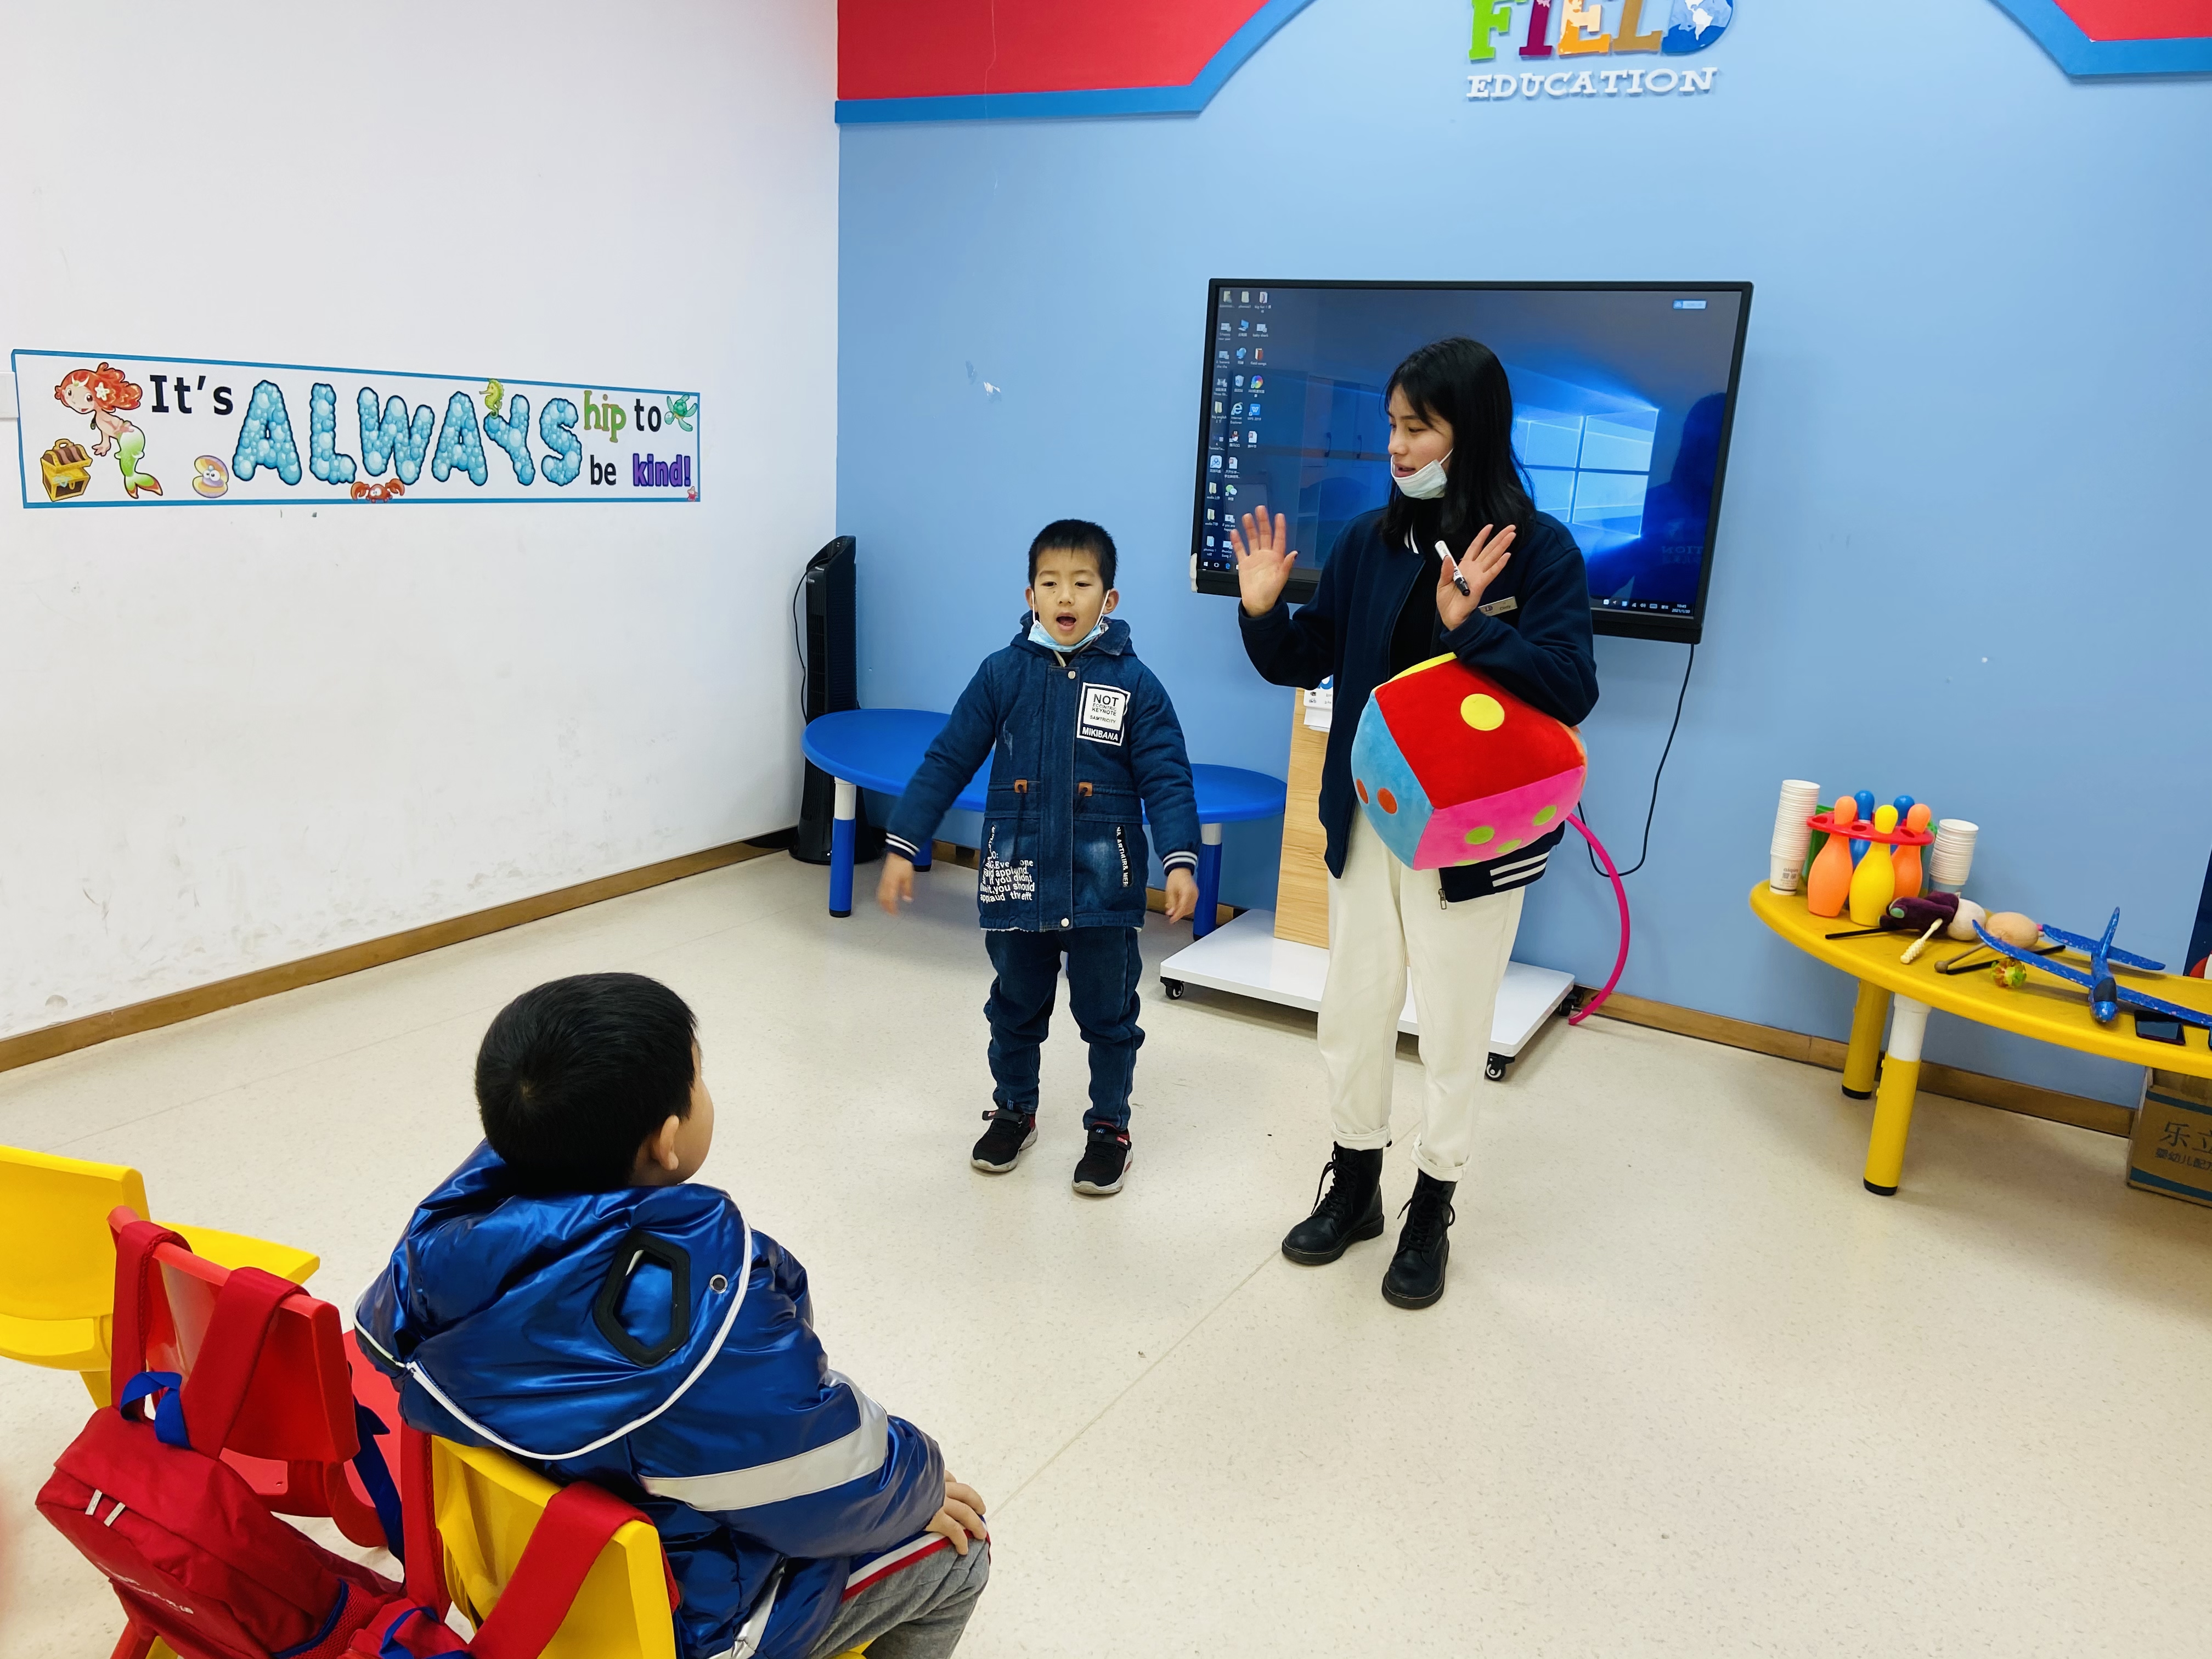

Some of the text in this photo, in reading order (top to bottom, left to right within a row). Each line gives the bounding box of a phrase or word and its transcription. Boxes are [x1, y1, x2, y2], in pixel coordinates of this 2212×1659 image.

[1466, 67, 1718, 99] EDUCATION
[150, 374, 662, 486] It's ALWAYS hip to
[590, 454, 692, 488] be kind!
[1093, 693, 1119, 707] NOT
[1092, 707, 1116, 716] KEYNOTE
[1082, 726, 1119, 741] MIKIBANA
[995, 876, 1012, 886] you
[1012, 881, 1035, 892] should
[2155, 1148, 2212, 1171] 婴幼儿配
